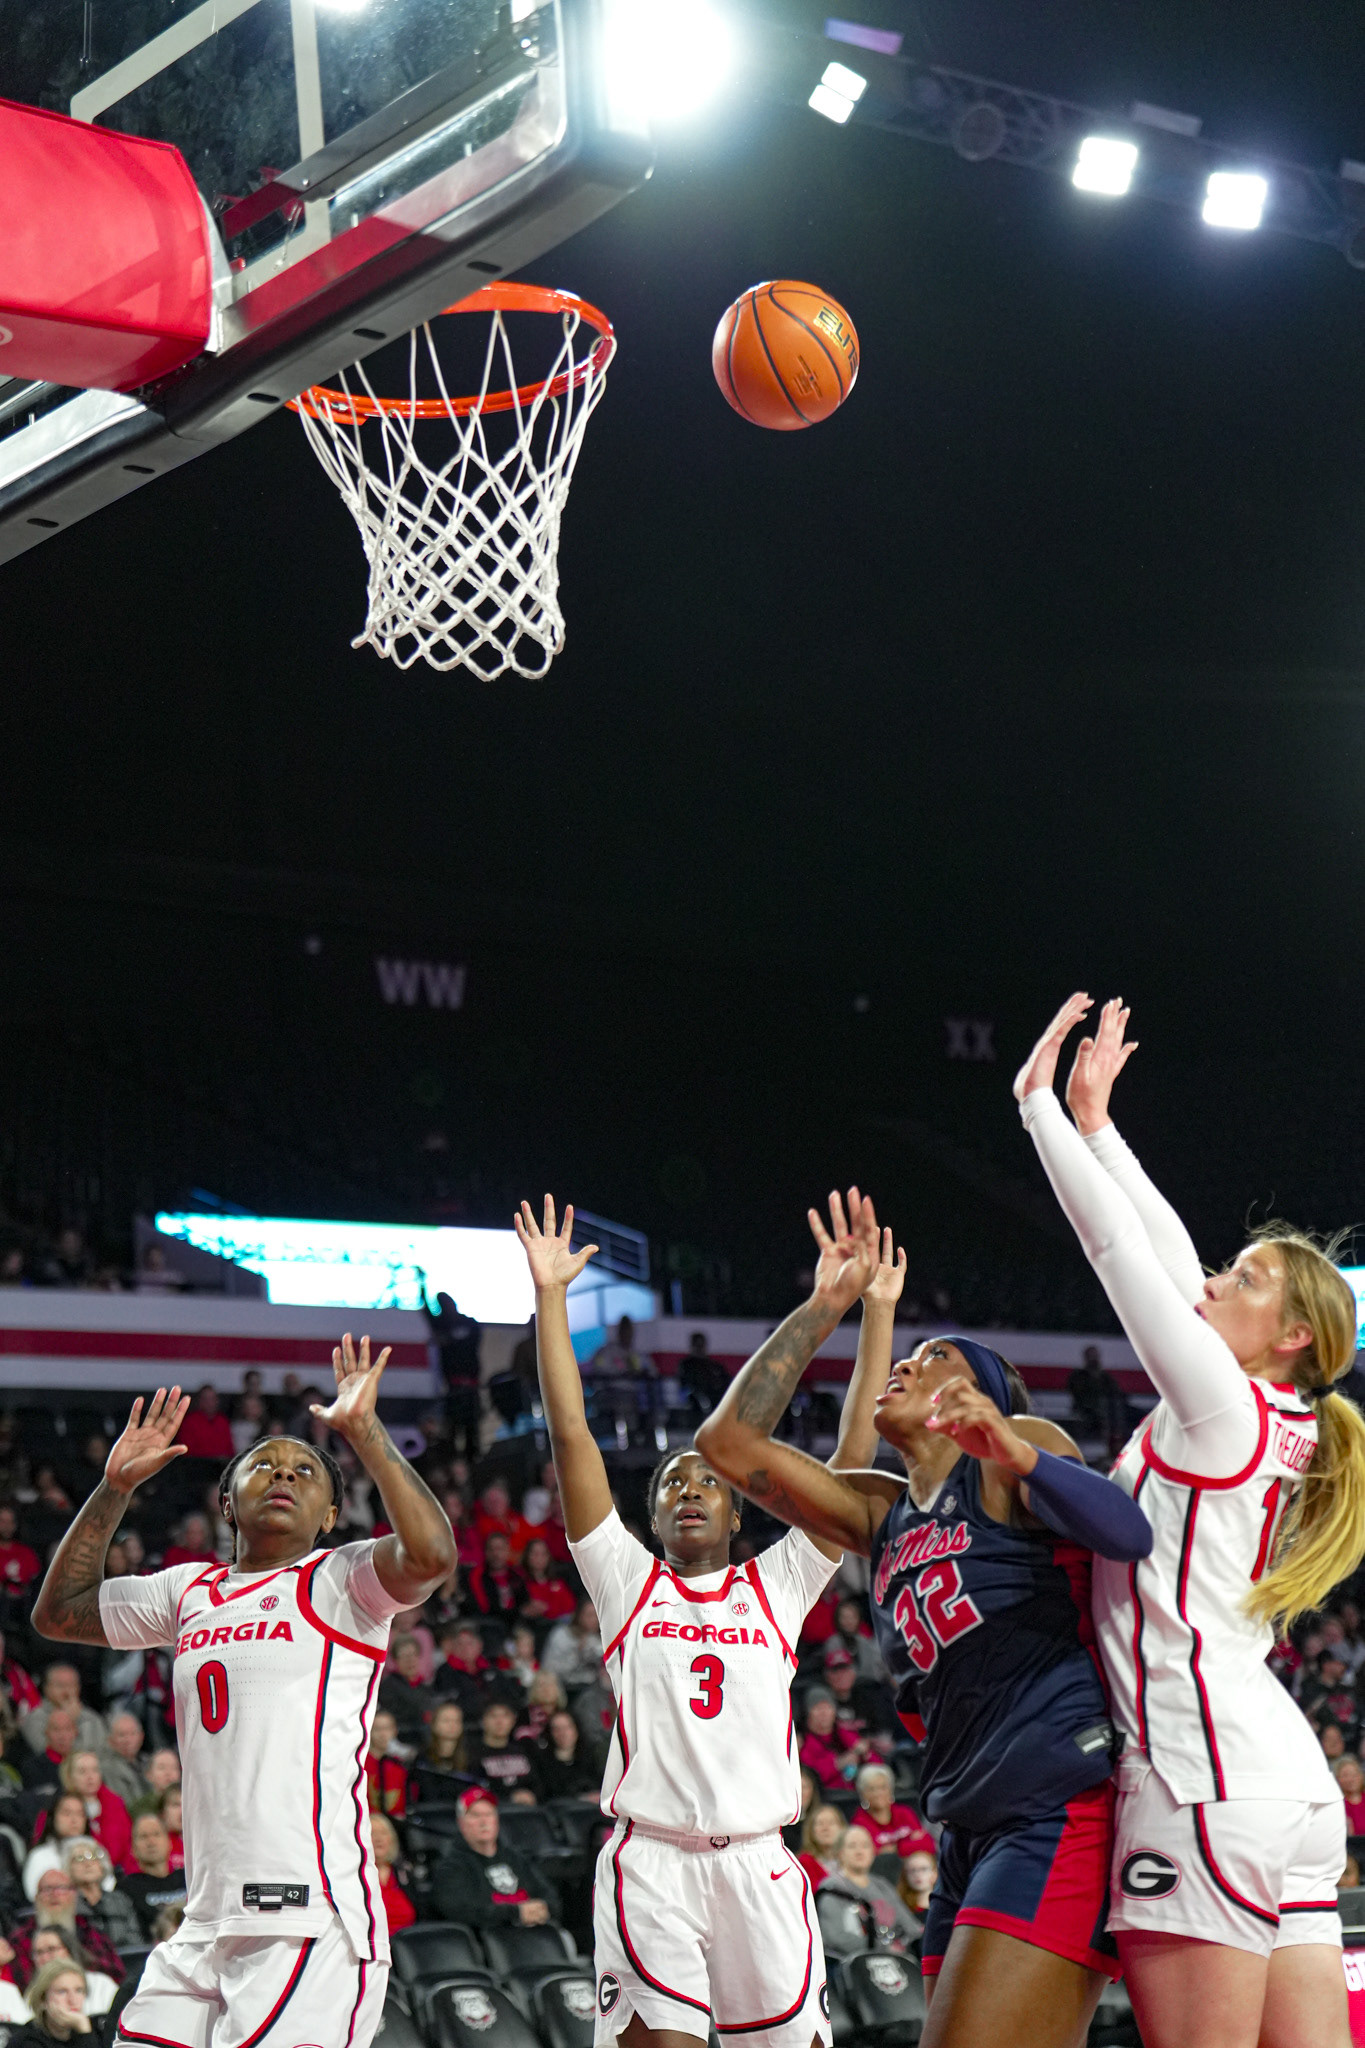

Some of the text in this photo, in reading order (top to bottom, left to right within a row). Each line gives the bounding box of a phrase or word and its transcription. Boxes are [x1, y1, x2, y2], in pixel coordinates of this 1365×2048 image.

[816, 305, 858, 377] ELITE
[377, 959, 465, 1009] WW
[892, 1518, 972, 1579] Miss
[260, 1595, 279, 1611] SEC
[733, 1602, 749, 1616] SEC
[893, 1559, 984, 1673] 32
[642, 1620, 770, 1649] GEORGIA
[196, 1660, 230, 1735] 0
[689, 1653, 725, 1720] 3
[287, 1890, 300, 1900] 42
[1120, 1850, 1181, 1899] G
[599, 1973, 621, 2015] G
